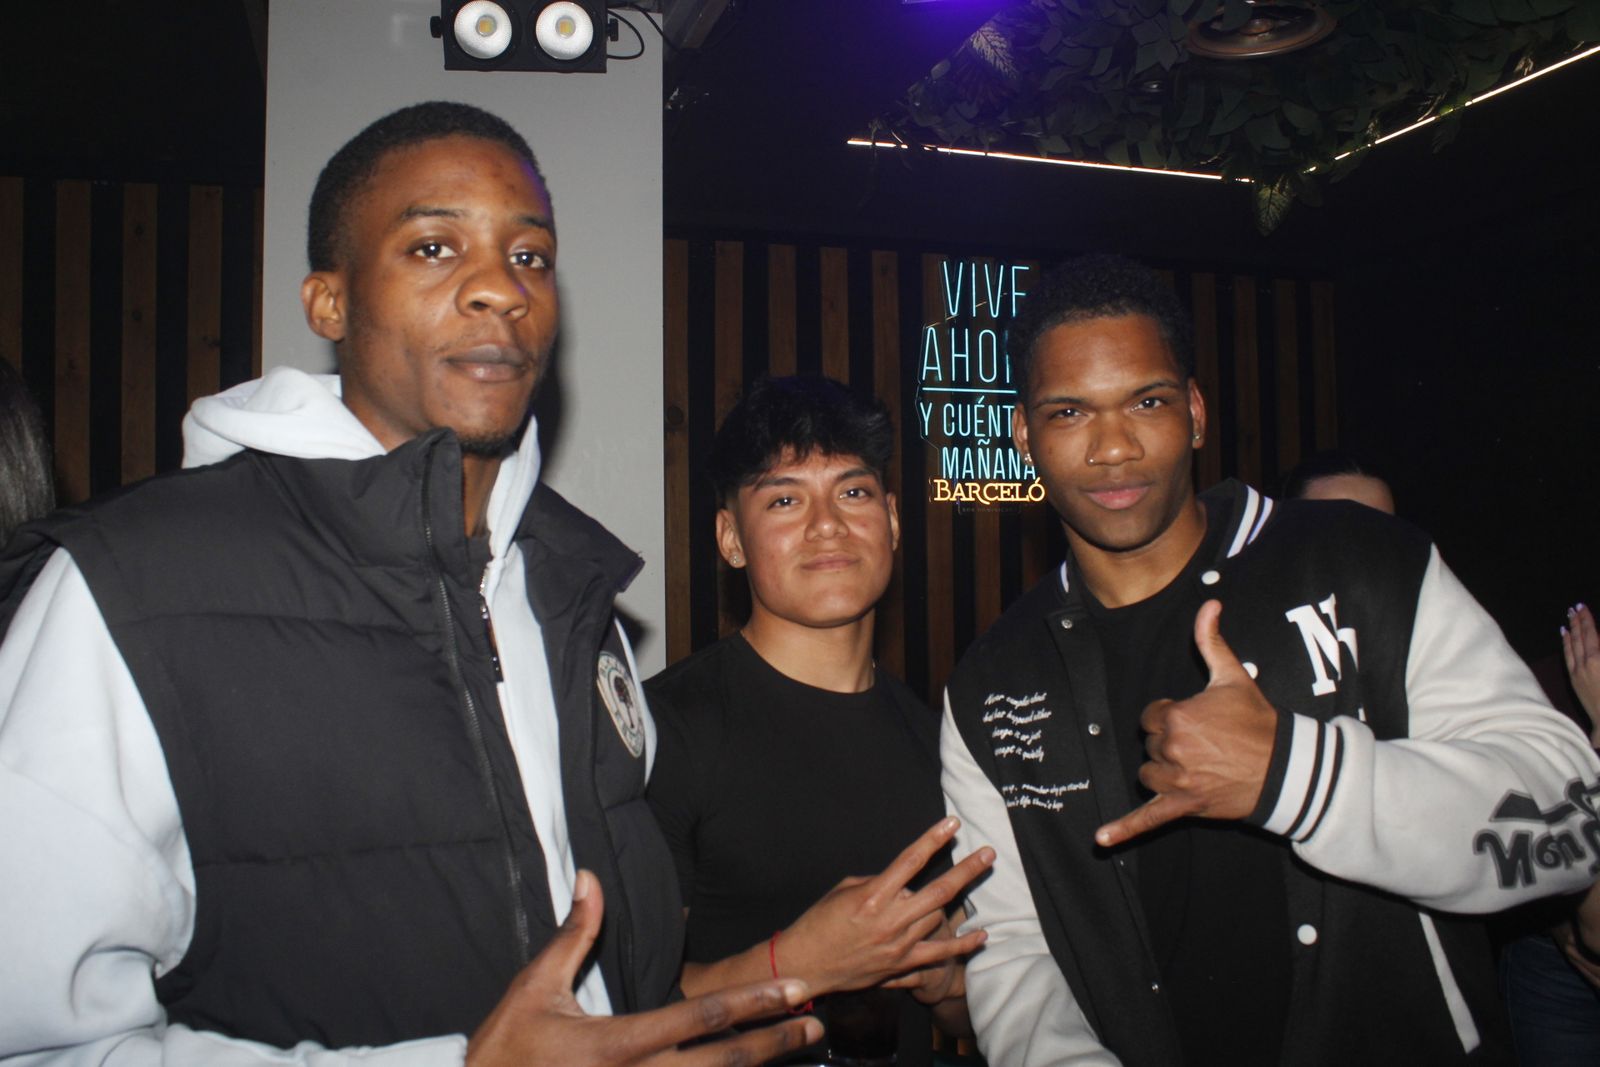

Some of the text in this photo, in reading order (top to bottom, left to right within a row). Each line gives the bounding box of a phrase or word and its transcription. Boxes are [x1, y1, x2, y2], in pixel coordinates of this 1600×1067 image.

[922, 326, 1010, 384] AHO
[919, 395, 1015, 438] Y CUÉNT
[932, 477, 1046, 506] BARCELÓ
